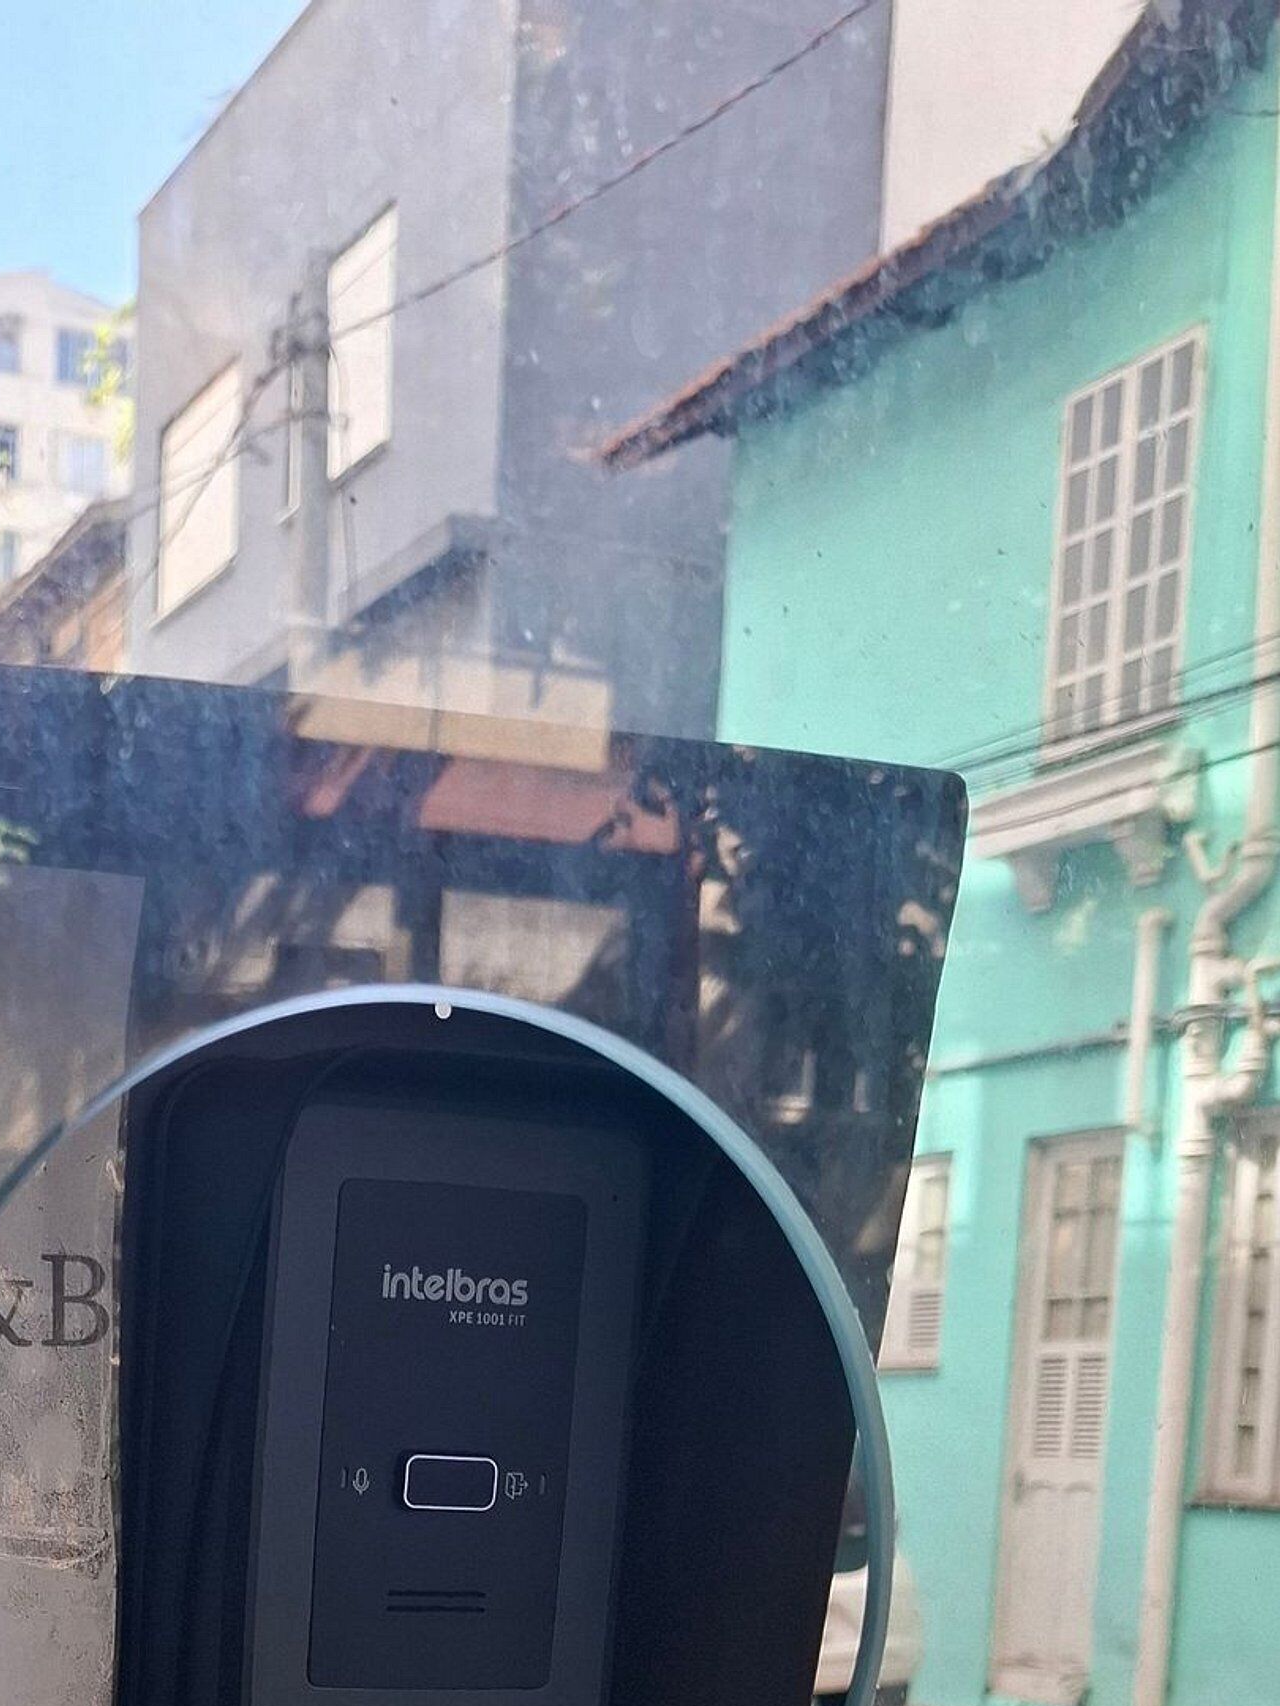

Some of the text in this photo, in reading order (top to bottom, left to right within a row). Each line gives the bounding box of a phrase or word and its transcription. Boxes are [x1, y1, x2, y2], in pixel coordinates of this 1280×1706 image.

[382, 1264, 528, 1306] intelbras
[450, 1311, 526, 1327] XPE 1001 FIT
